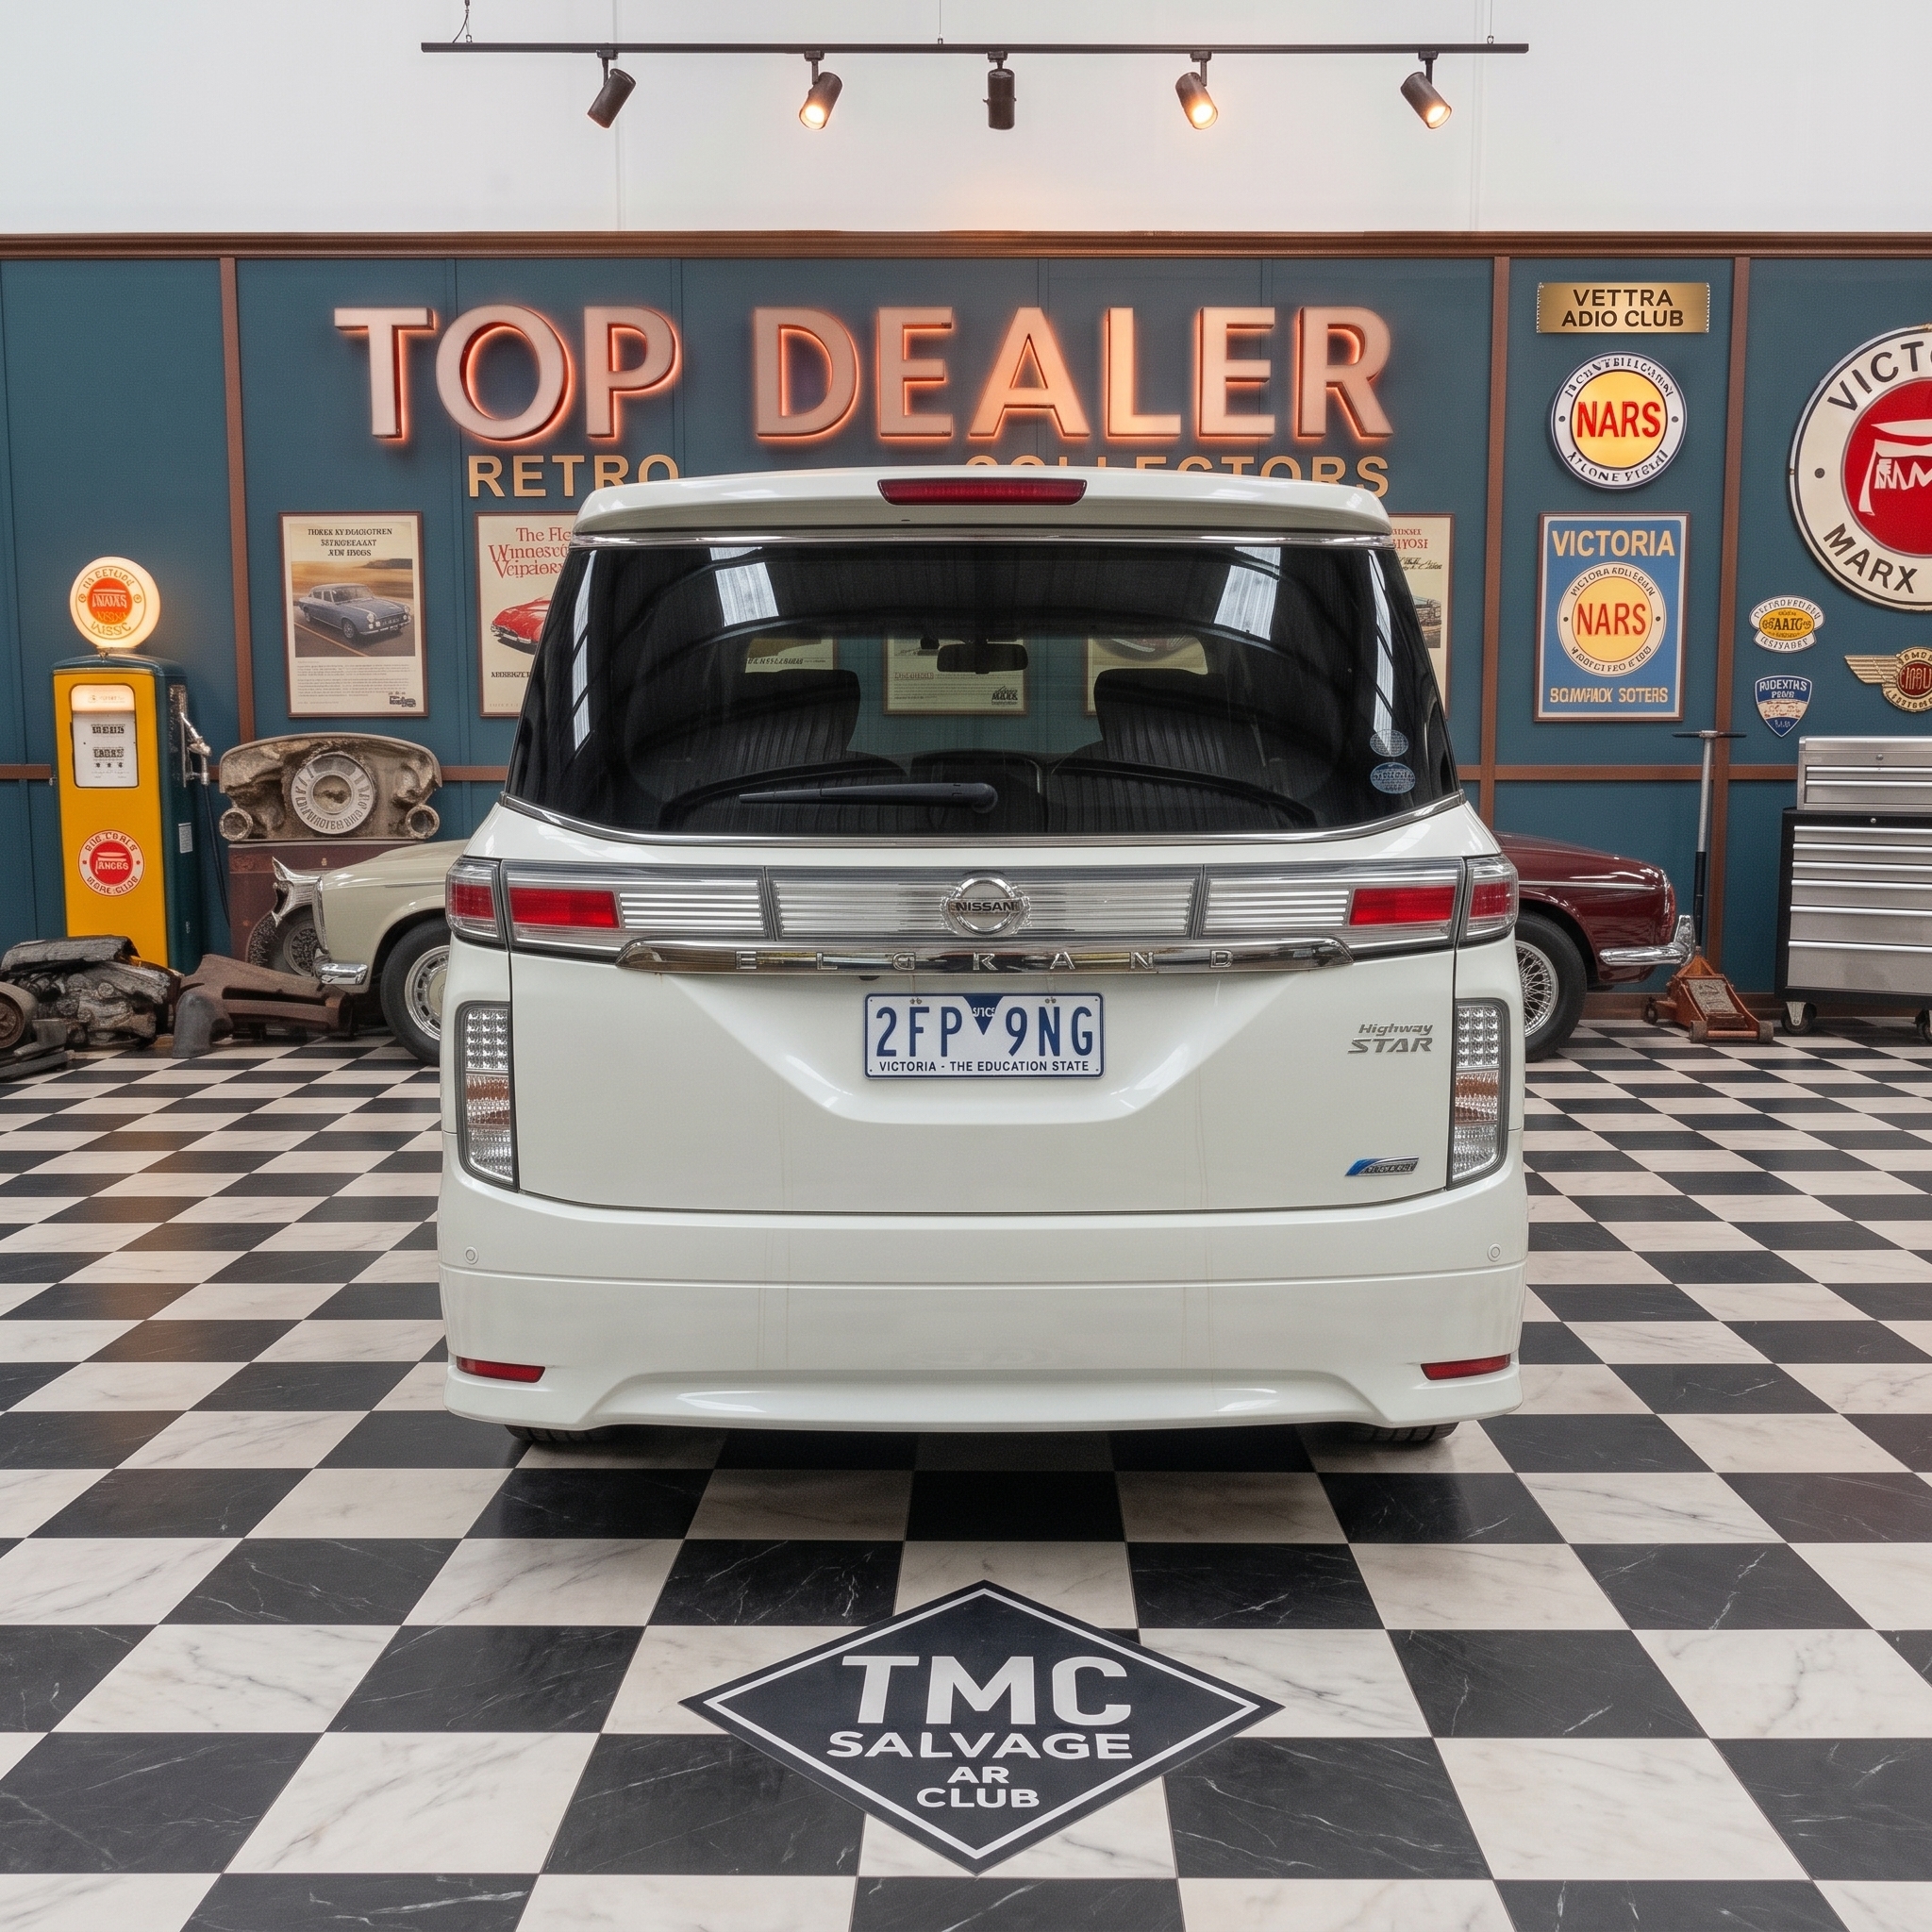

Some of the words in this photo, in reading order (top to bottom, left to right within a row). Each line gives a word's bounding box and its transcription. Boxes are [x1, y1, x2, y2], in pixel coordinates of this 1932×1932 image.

[1573, 289, 1674, 307] VETTRA
[1561, 310, 1618, 327] ADIO
[1624, 309, 1684, 327] CLUB
[334, 304, 677, 441] TOP
[755, 307, 1393, 439] DEALER
[1827, 341, 1932, 411] VICT
[1576, 401, 1661, 438] NARS
[468, 454, 679, 497] RETRO
[515, 527, 544, 541] The
[1552, 530, 1675, 557] VICTORIA
[1823, 523, 1917, 593] MARX
[1576, 603, 1646, 636] NARS
[955, 901, 1015, 911] NISSAN
[735, 951, 1234, 972] ELGRAND
[875, 1006, 963, 1058] 2FP
[1005, 1006, 1093, 1058] 9NG
[1358, 1024, 1433, 1037] Highway
[1347, 1037, 1433, 1054] STAR
[879, 1061, 937, 1072] VICTORIA
[950, 1061, 973, 1072] THE
[977, 1060, 1047, 1072] EDUCATION
[1052, 1060, 1089, 1072] STATE
[841, 1656, 1132, 1726] TMC
[826, 1732, 1133, 1760] SALVAGE
[947, 1766, 1009, 1784] AR
[916, 1788, 1041, 1809] CLUB
